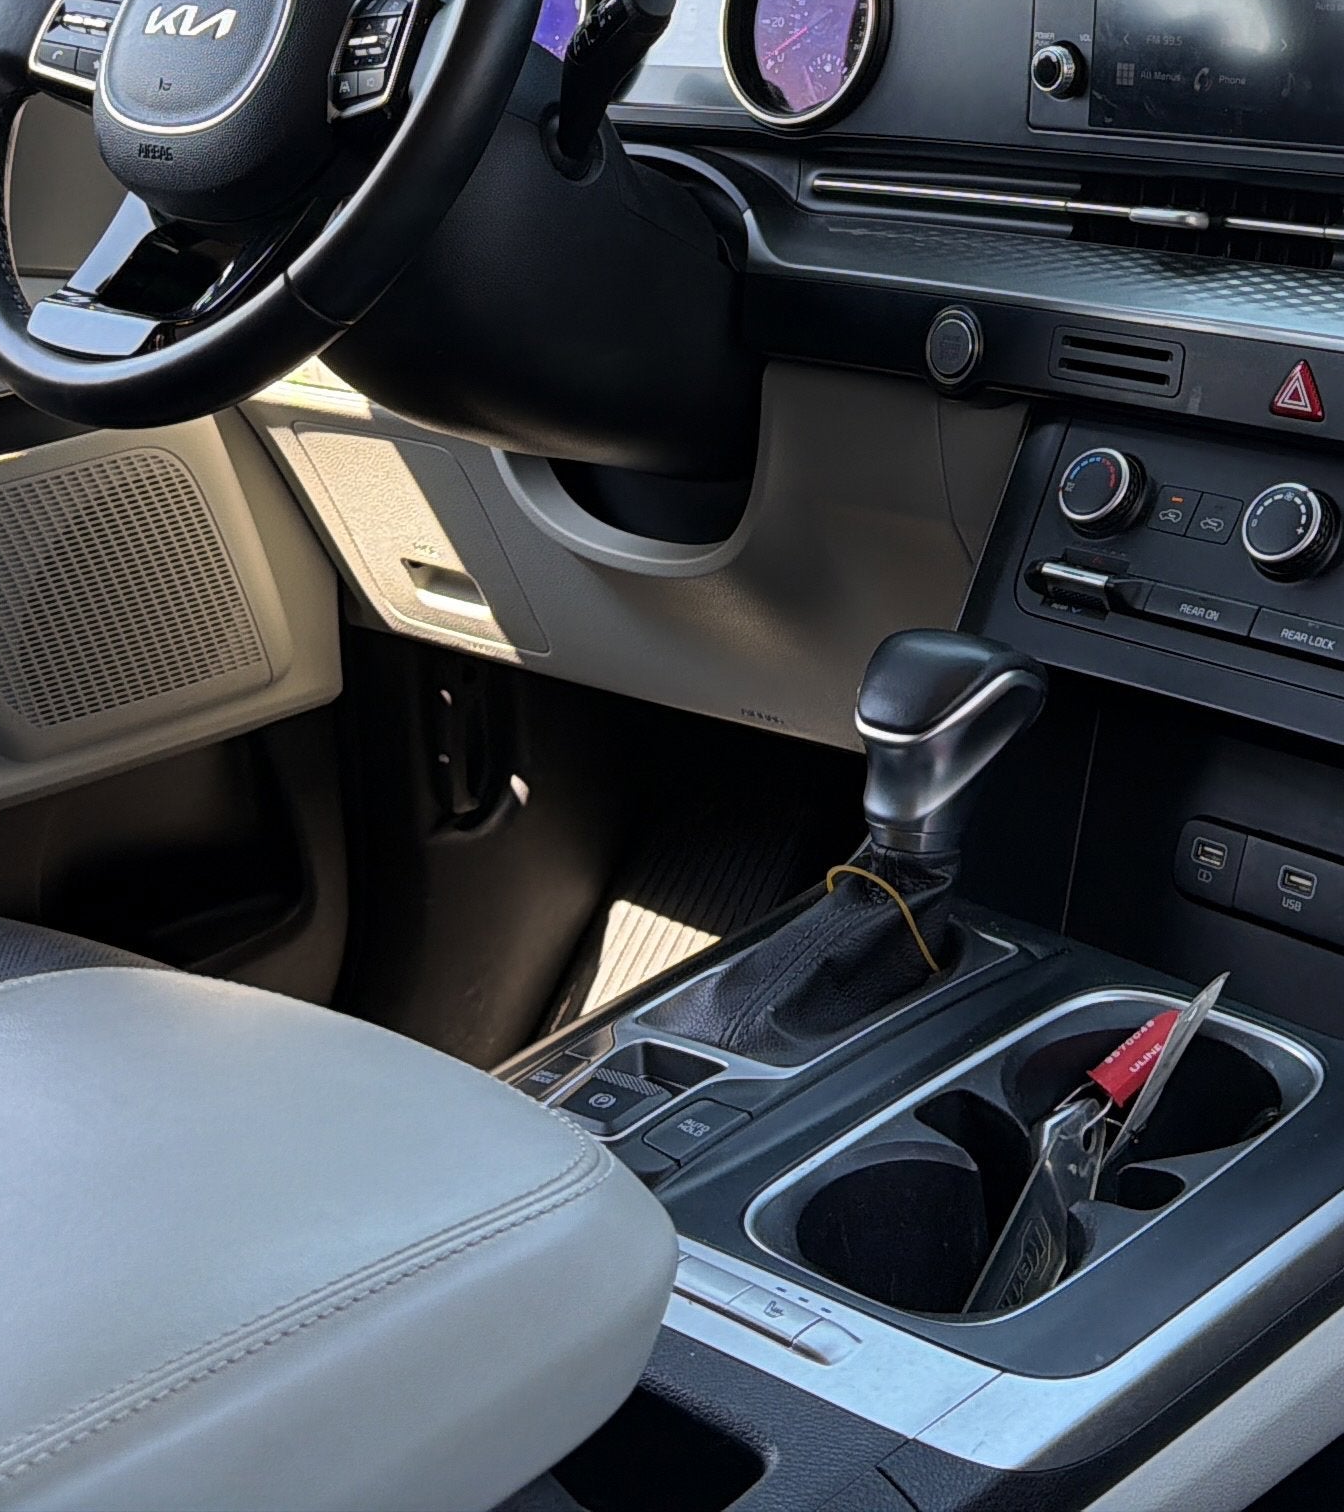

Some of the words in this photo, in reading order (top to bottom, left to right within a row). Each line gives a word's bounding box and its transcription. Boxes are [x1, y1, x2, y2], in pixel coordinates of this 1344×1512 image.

[144, 4, 237, 40] KIA
[771, 17, 785, 27] 20
[1218, 74, 1247, 85] Phone
[1179, 603, 1206, 618] REAR
[1205, 609, 1221, 622] ON
[1280, 628, 1308, 644] REAR
[1308, 635, 1337, 651] LOCK
[1281, 897, 1302, 913] USB
[1128, 1042, 1163, 1073] ULINE
[676, 1123, 704, 1138] HOLD
[682, 1118, 711, 1133] AUTO
